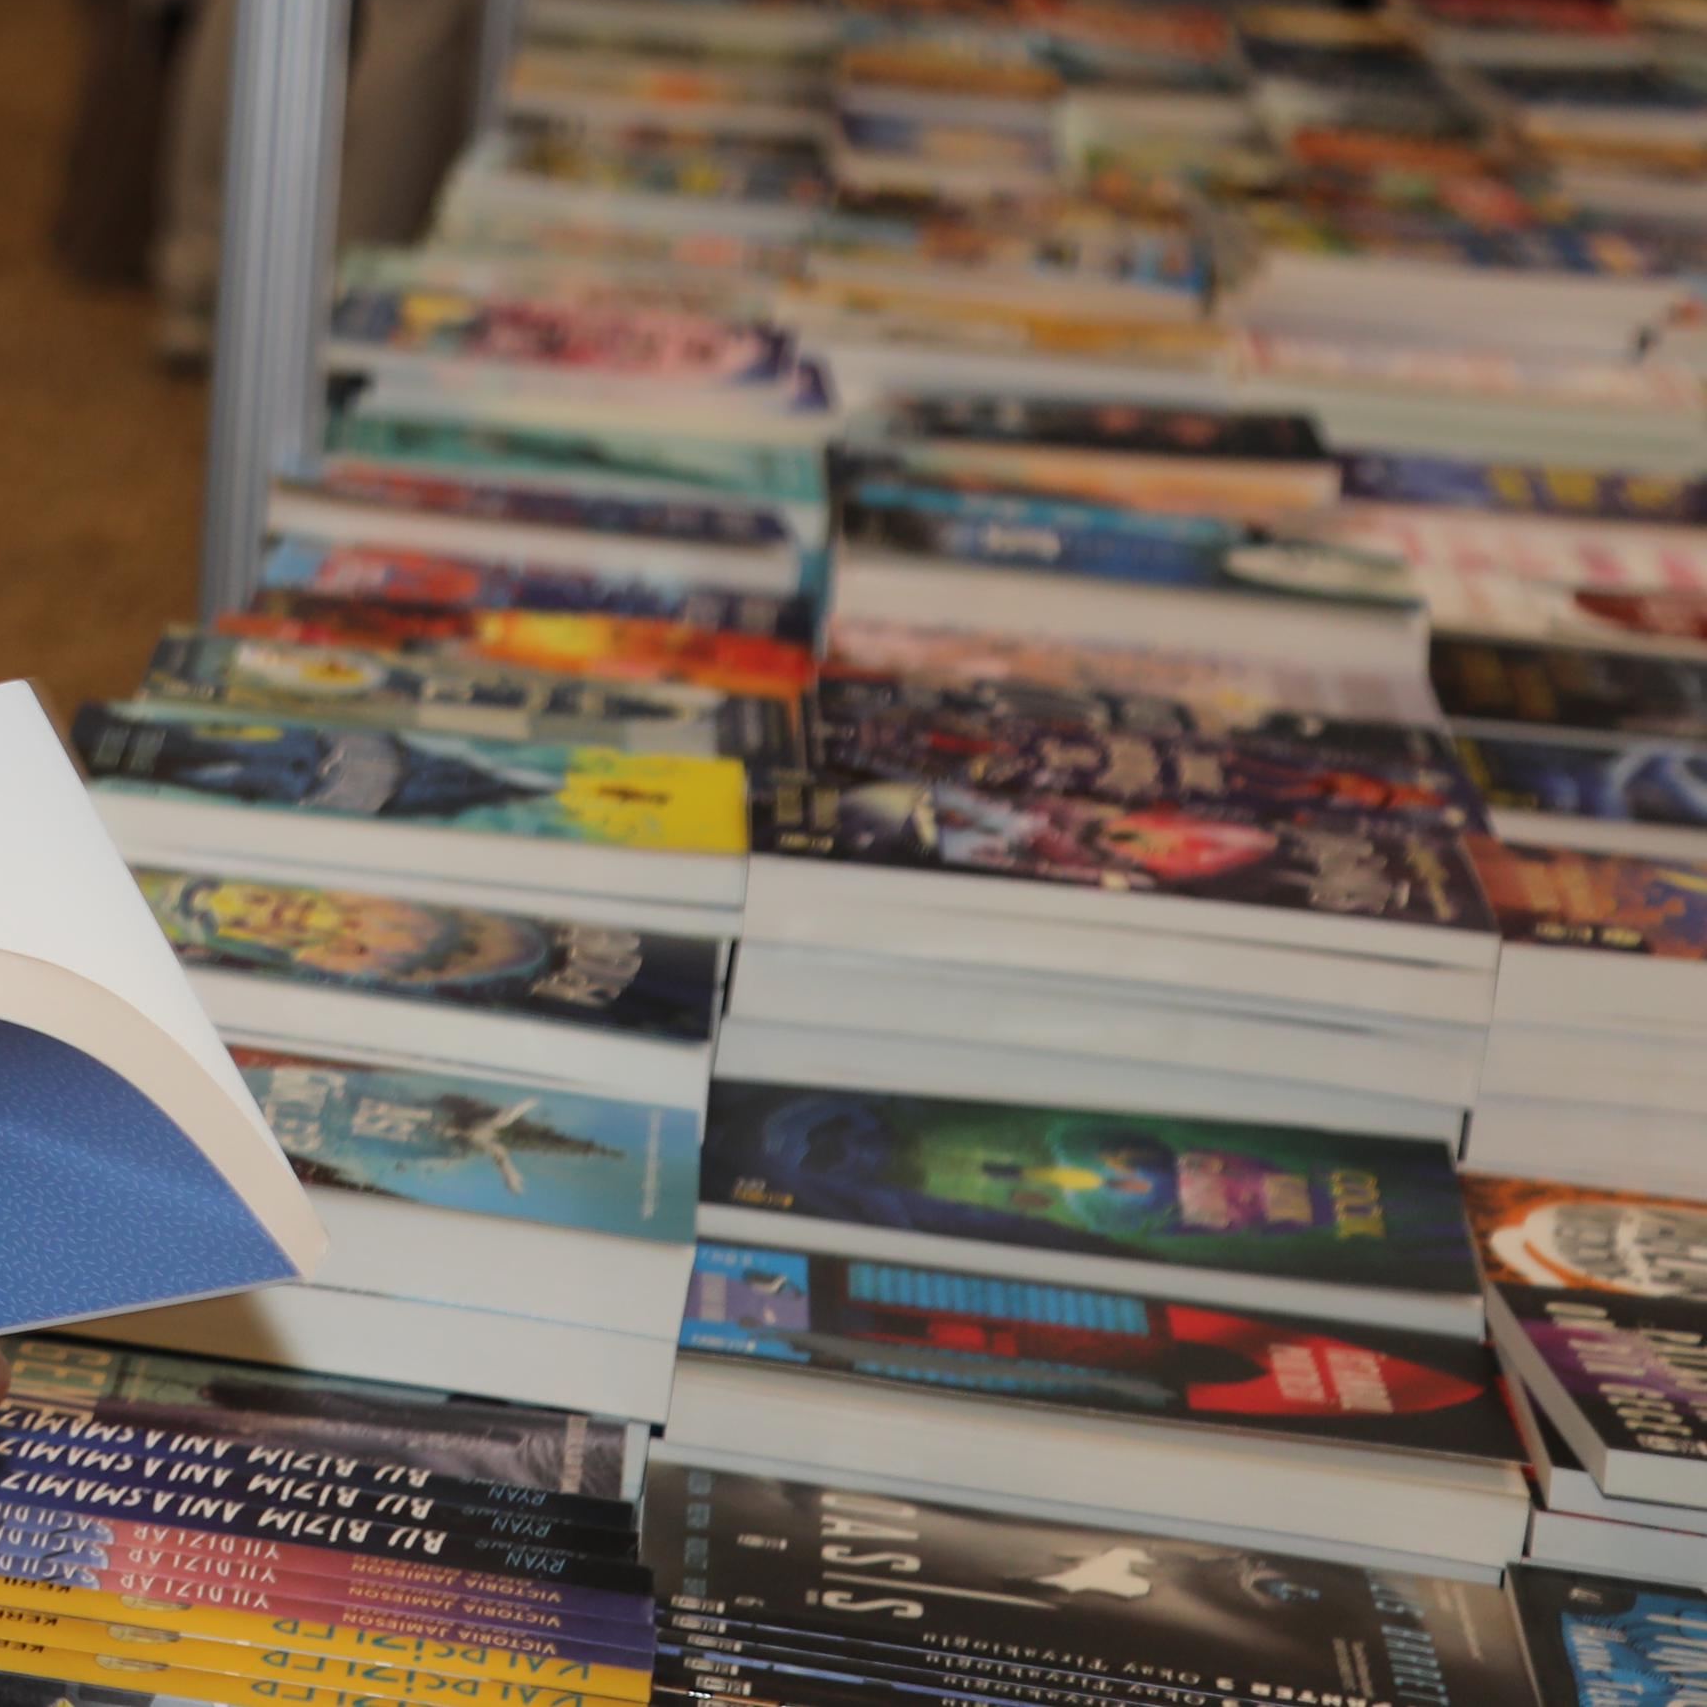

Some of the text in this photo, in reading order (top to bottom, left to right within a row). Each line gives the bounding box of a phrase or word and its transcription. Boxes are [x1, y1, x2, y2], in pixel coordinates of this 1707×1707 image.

[374, 1466, 432, 1489] BU
[376, 1494, 436, 1521] BU
[488, 1485, 547, 1507] RYAN
[491, 1517, 552, 1539] RYAN
[388, 1527, 448, 1555] BU
[504, 1550, 567, 1574] RYAN
[465, 1578, 563, 1603] VICTORIA
[462, 1603, 561, 1628] VICTORIA
[458, 1629, 557, 1655] VICTORIA
